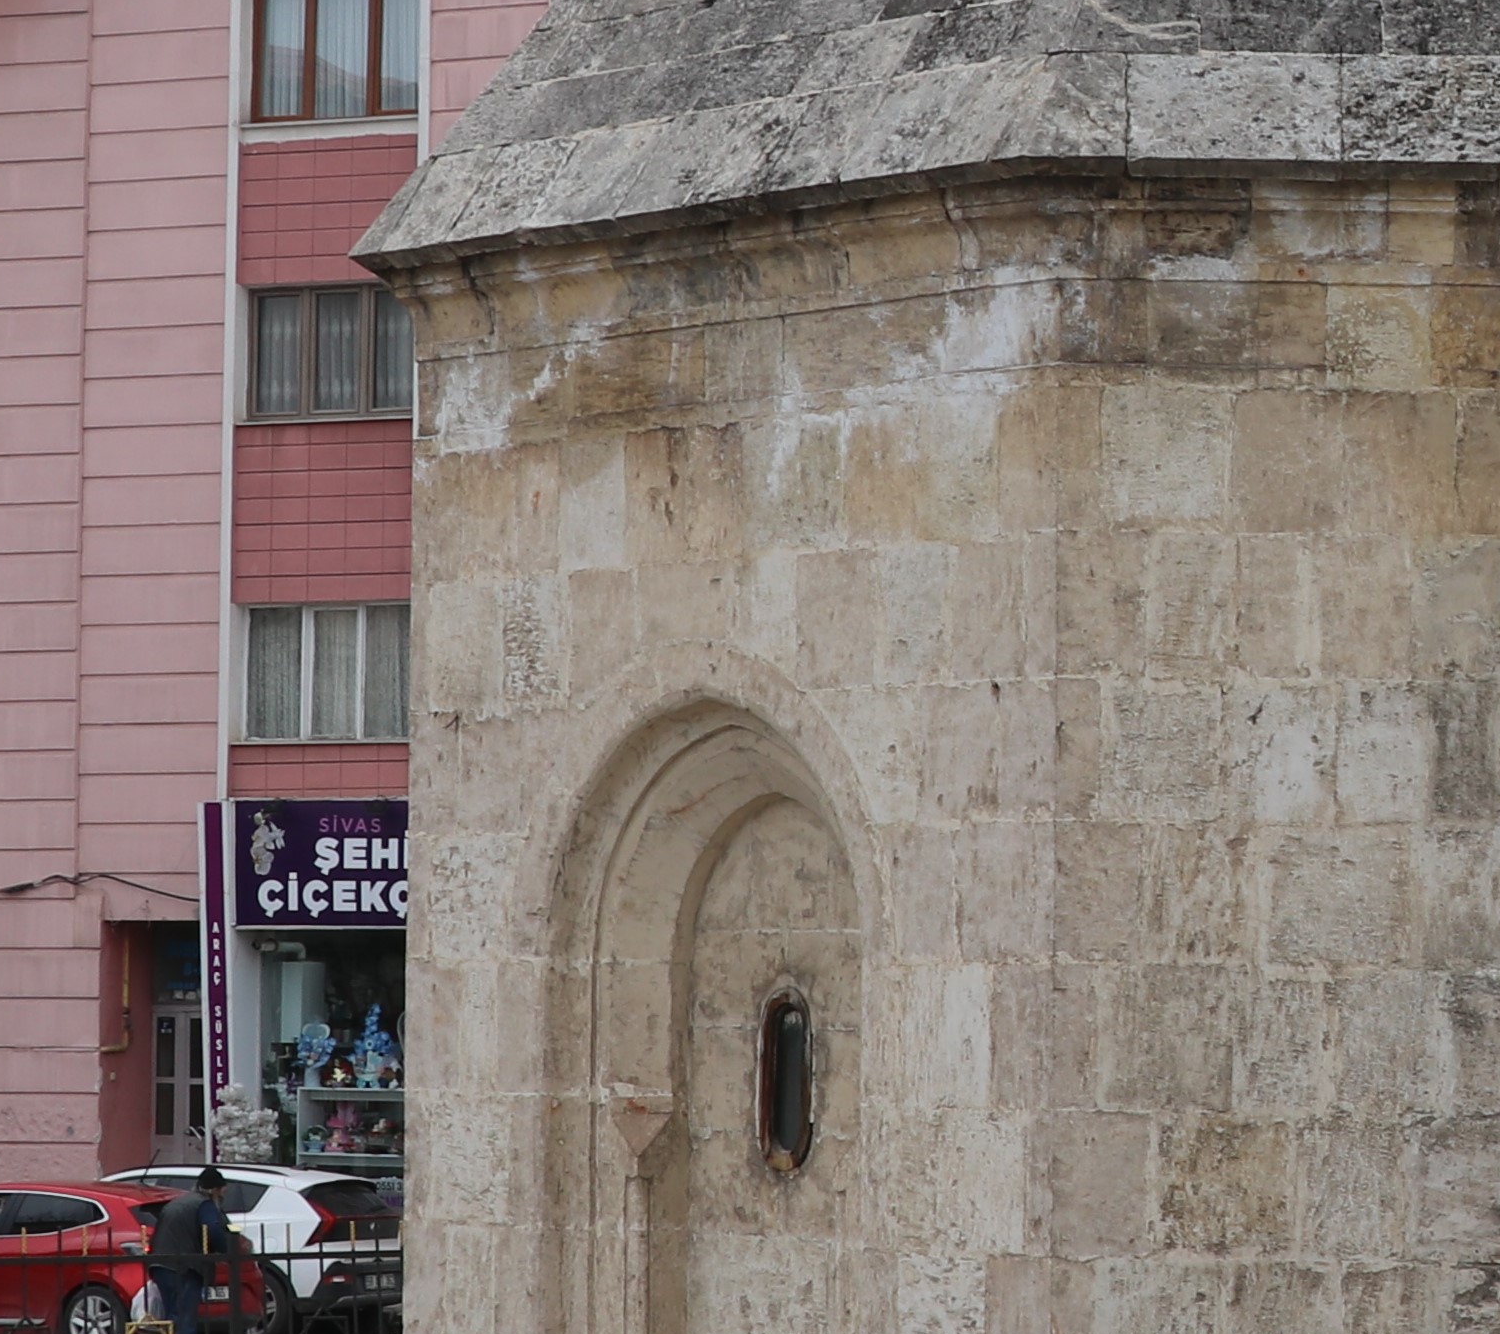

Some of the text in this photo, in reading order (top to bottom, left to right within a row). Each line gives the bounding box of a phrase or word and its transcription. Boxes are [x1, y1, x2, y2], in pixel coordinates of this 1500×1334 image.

[319, 814, 382, 833] SİVAS
[314, 829, 409, 876] ŞEHİ
[257, 871, 409, 919] ÇİÇEKÇ
[211, 921, 223, 1099] ARAÇ SÜSLE
